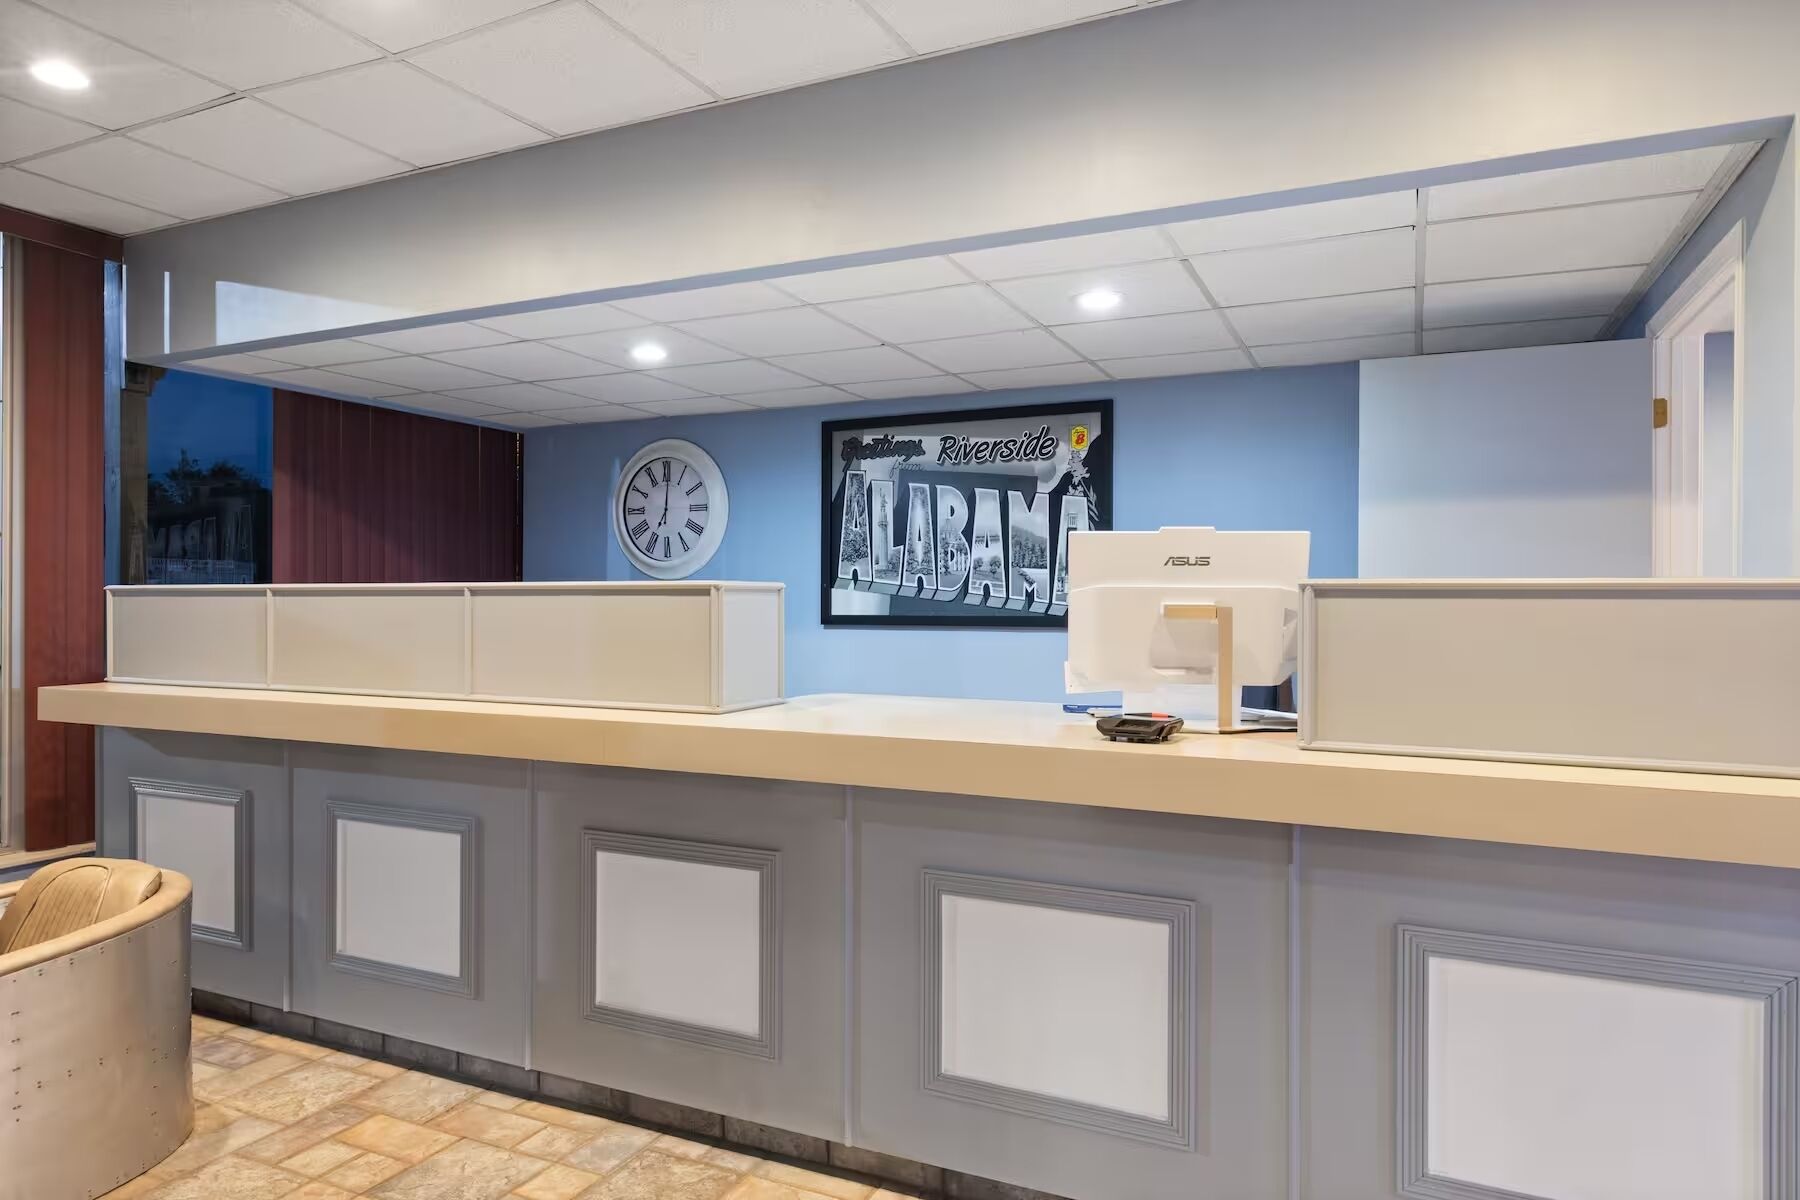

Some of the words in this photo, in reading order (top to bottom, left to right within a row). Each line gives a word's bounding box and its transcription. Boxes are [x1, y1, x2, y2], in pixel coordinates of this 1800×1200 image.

[936, 424, 1058, 467] Riverside
[1075, 433, 1086, 445] 8
[631, 484, 649, 499] X
[1164, 556, 1211, 566] ASUS
